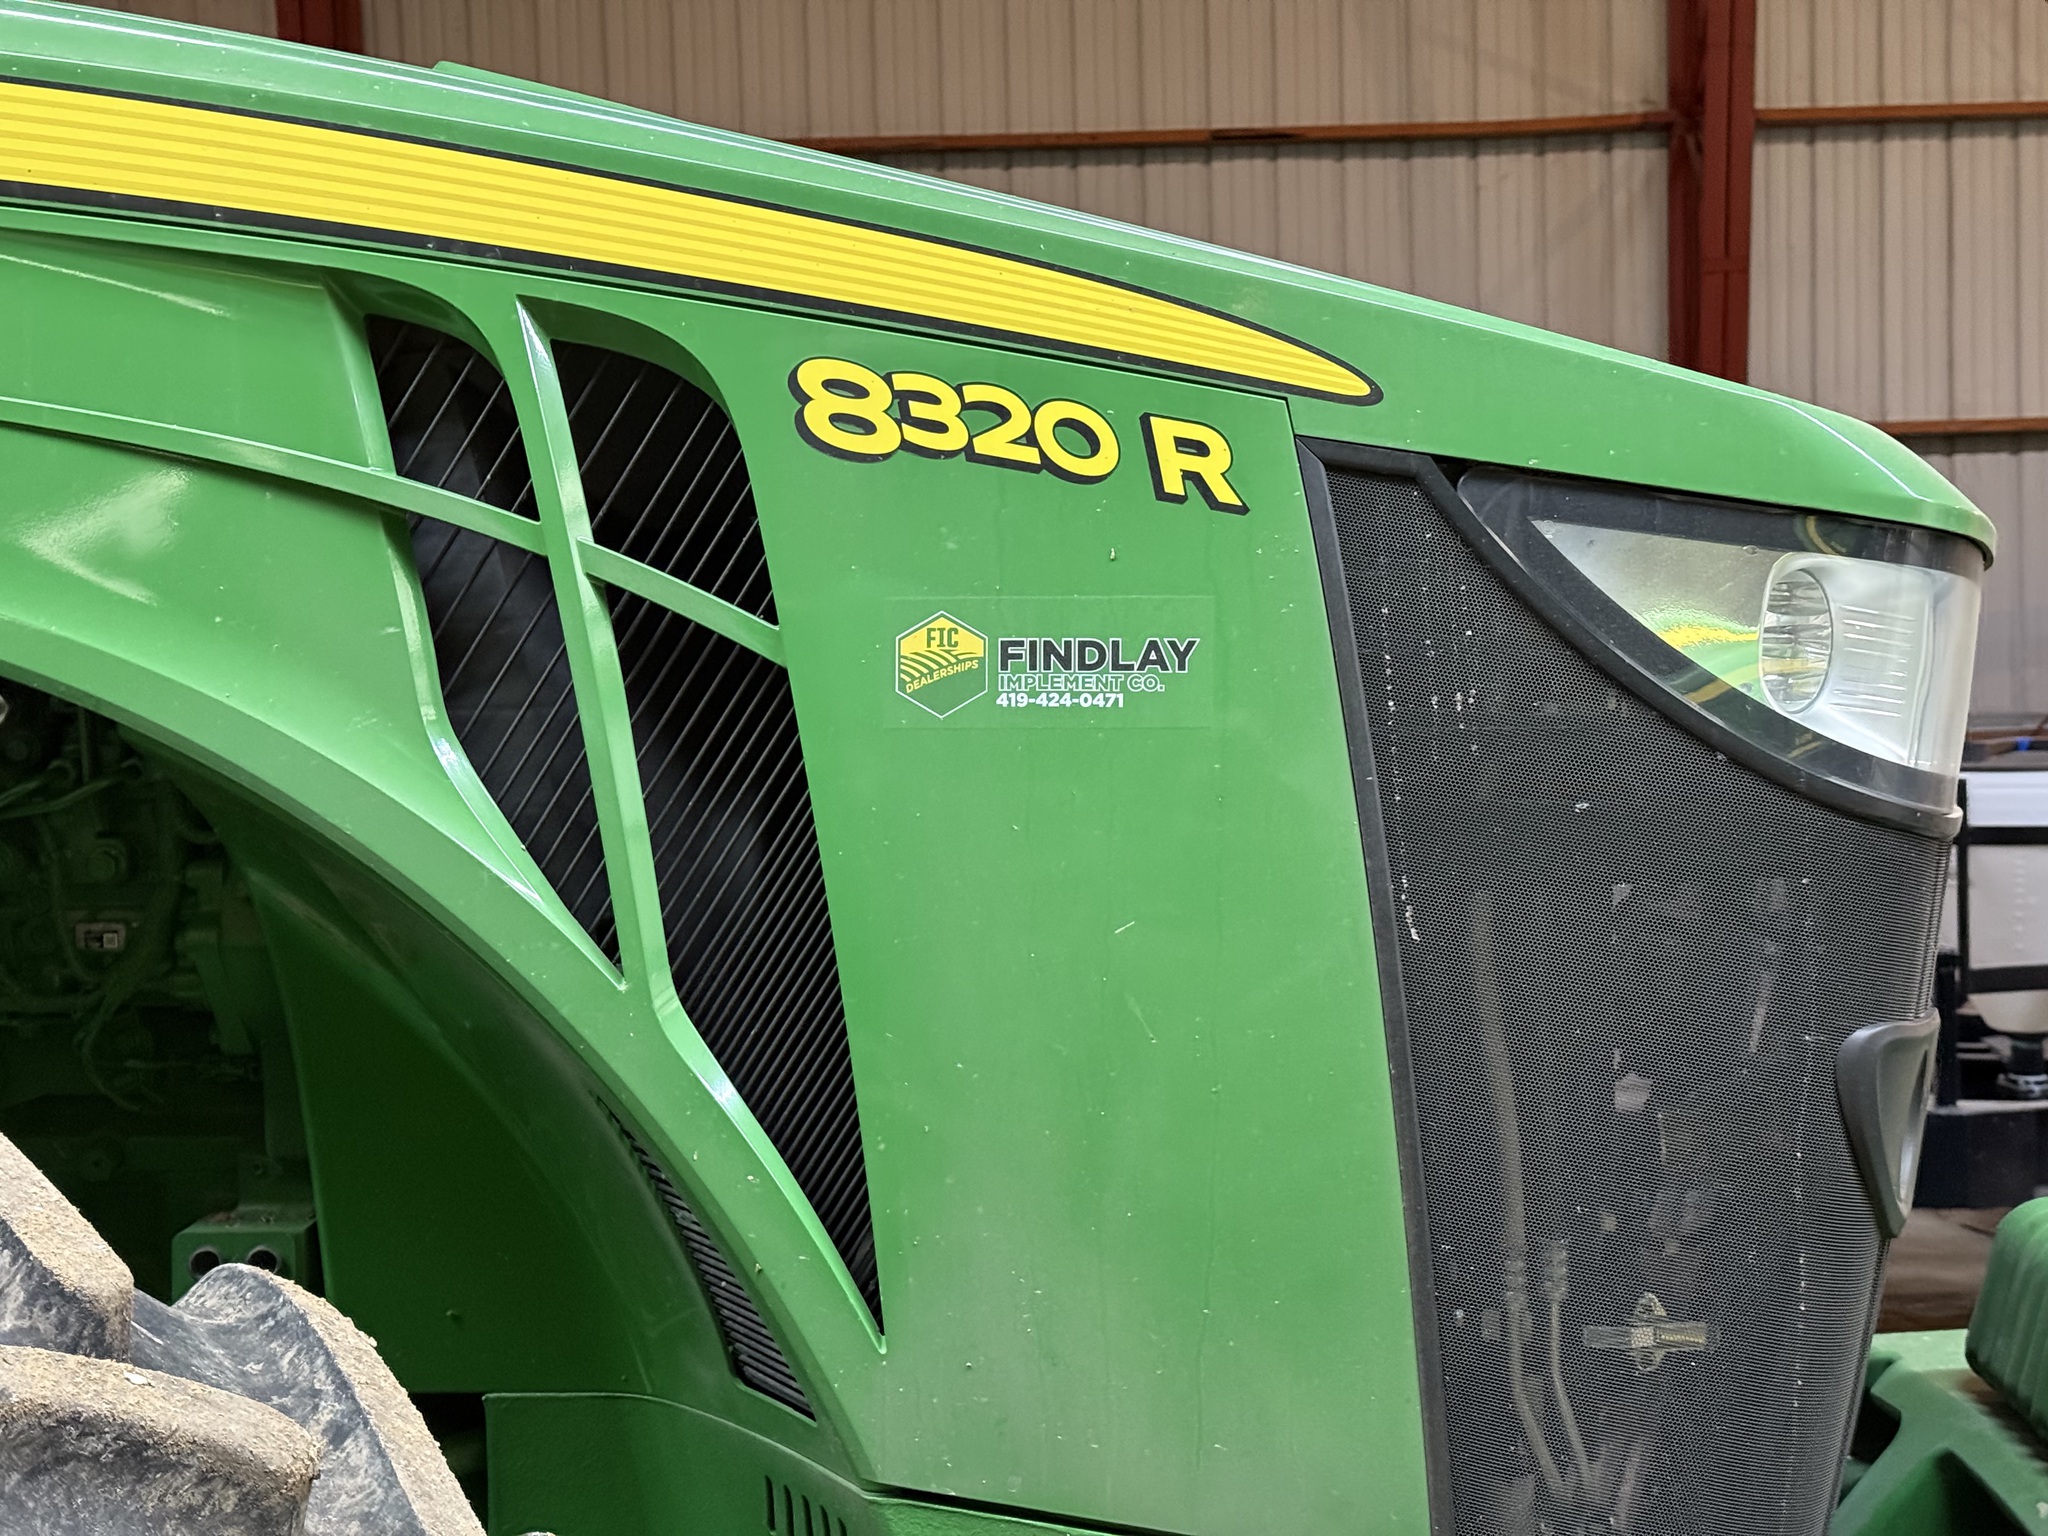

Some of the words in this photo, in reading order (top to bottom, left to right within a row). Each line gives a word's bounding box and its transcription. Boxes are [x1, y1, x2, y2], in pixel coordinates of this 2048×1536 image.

[788, 357, 1120, 484] 8320
[1139, 412, 1249, 515] R
[926, 628, 959, 648] FIC
[998, 638, 1199, 673] FINDLAY
[905, 660, 979, 694] DEALERSHIPS
[998, 674, 1124, 692] IMPLEMENT
[1127, 674, 1165, 692] CO.
[995, 693, 1124, 708] 419-424-0471
